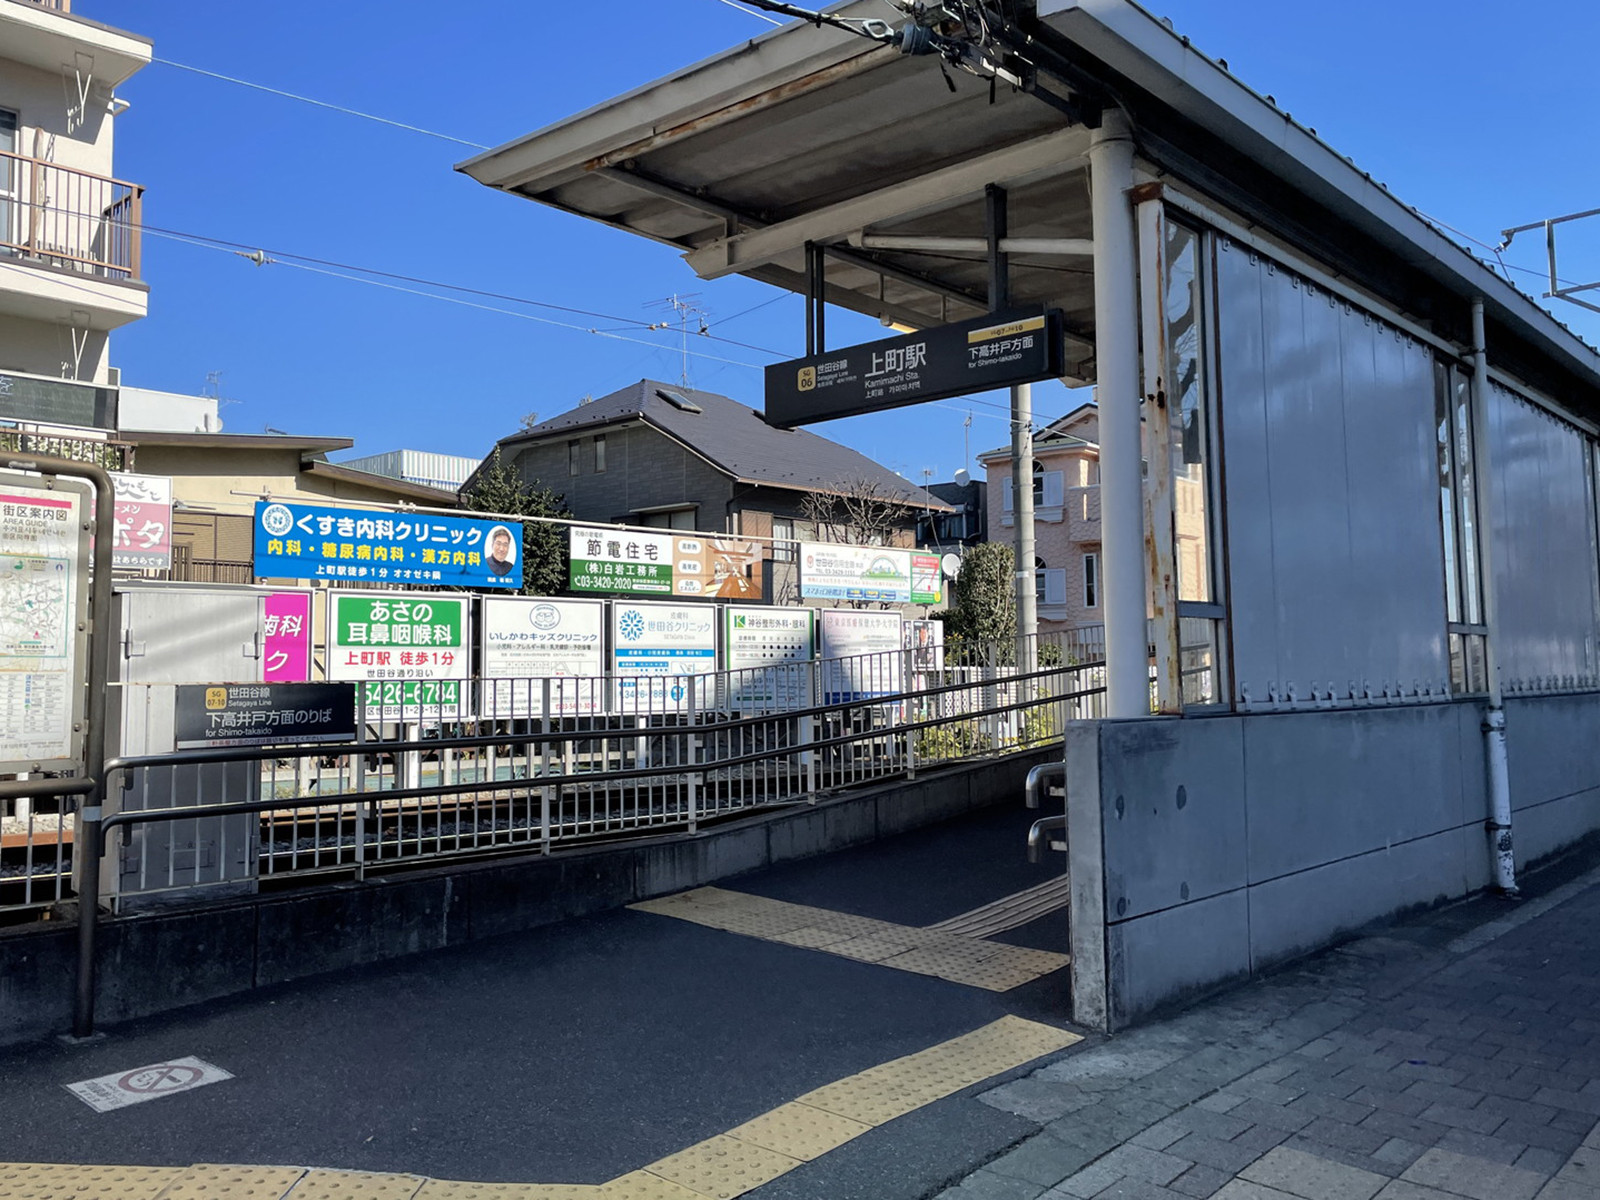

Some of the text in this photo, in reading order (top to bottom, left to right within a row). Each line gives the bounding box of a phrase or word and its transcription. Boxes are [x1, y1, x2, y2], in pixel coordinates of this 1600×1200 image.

[968, 335, 1034, 360] 下高井戸方面
[817, 360, 848, 374] 世田谷線
[865, 342, 927, 378] 上町駅
[978, 353, 1022, 367] Shimo-takaido
[801, 378, 813, 388] 06
[865, 375, 904, 388] Kamimachi
[3, 504, 68, 521] 街区案内図
[3, 518, 49, 528] AREA GUIDE
[296, 513, 482, 546] くすき内科クリニック
[267, 538, 482, 567] 内科・糖尿病内科・漢方内科
[586, 539, 658, 561] 節電住宅
[585, 562, 658, 577] (株)白岩工務所
[581, 576, 631, 590] 03-3420-2020
[370, 601, 433, 622] あさの
[347, 622, 452, 645] 耳鼻咽喉科
[648, 621, 711, 632] 世田谷クリニック
[489, 632, 598, 642] いしかわキッズクリニック
[266, 650, 289, 672] ク
[344, 651, 454, 666] 上町駅 徒歩1分
[367, 668, 434, 677] 世田谷通り沿い
[229, 687, 271, 699] 世田谷線
[207, 698, 226, 706] 07-10
[228, 700, 258, 708] Setagaya
[206, 708, 333, 728] 下高井戸方面のりば
[206, 727, 273, 737] for Shimo-takaido
